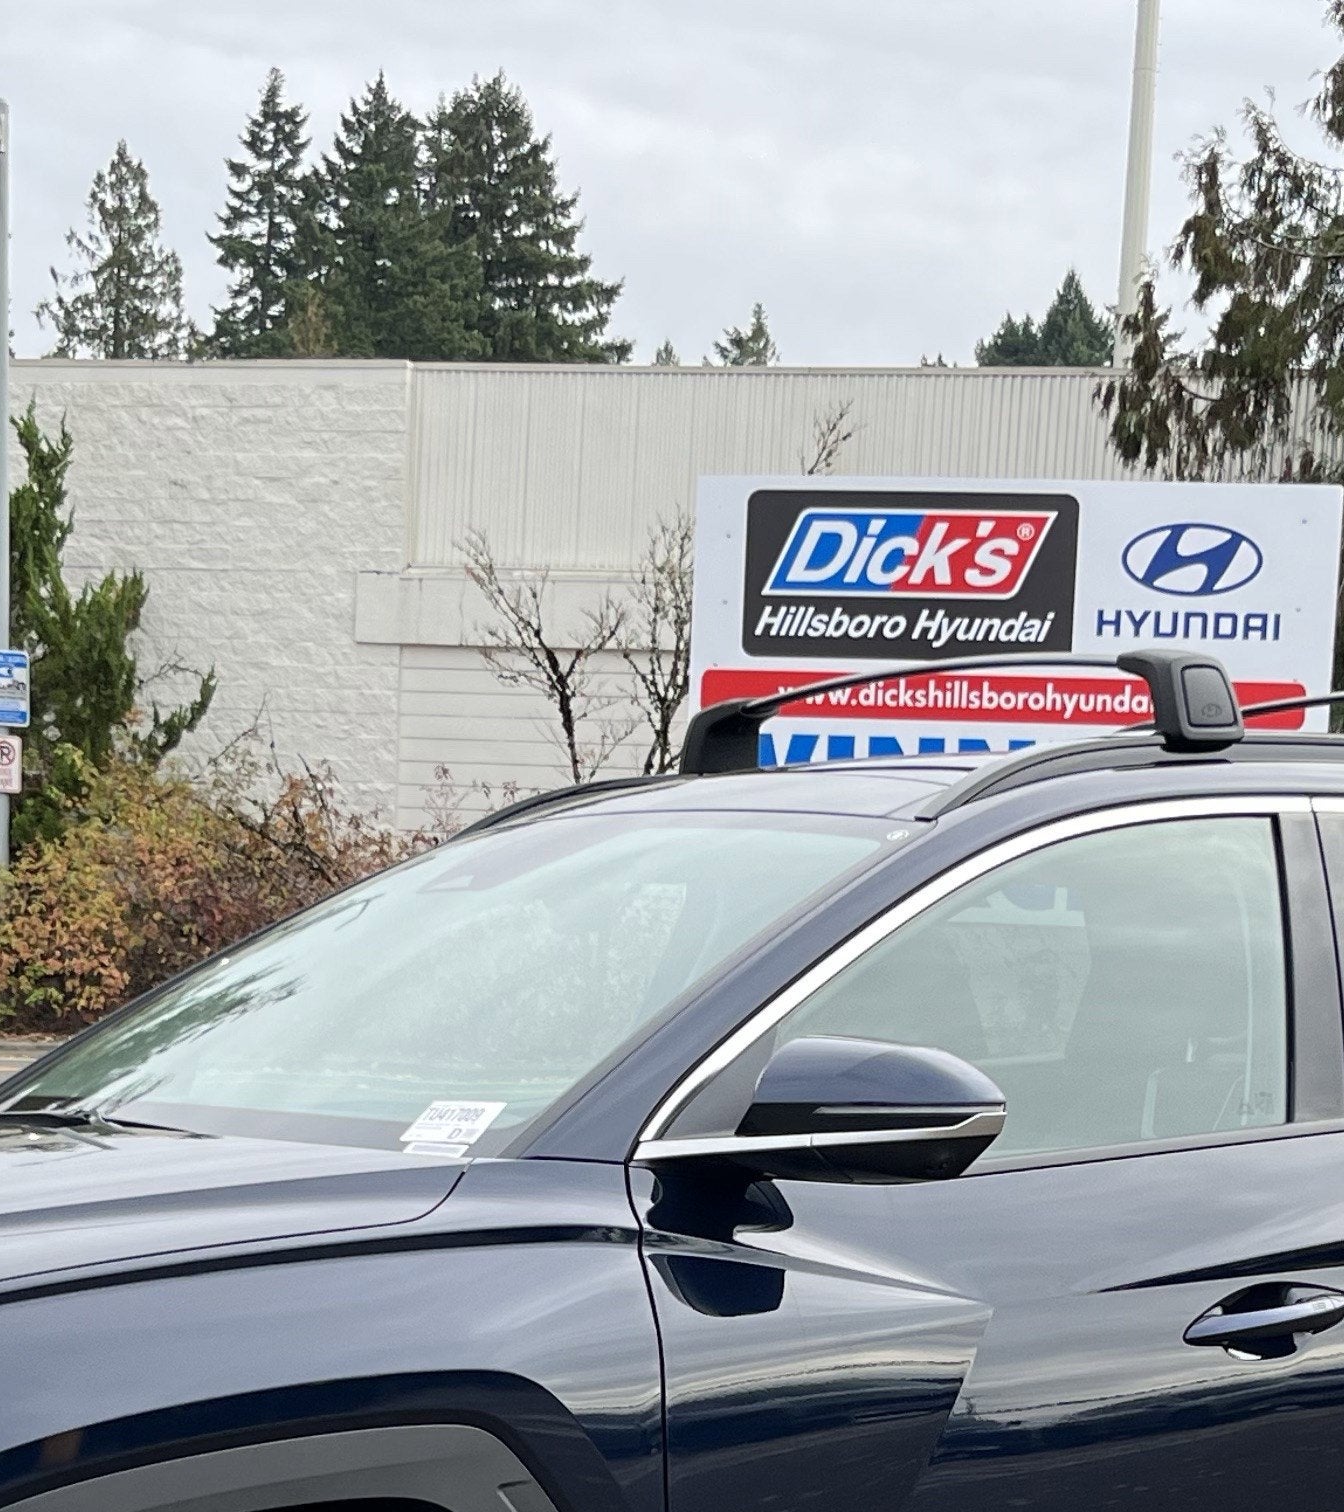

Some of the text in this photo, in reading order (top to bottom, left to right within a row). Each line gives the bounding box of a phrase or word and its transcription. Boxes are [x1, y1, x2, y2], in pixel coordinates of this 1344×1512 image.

[785, 518, 1020, 588] Dick's
[754, 604, 1056, 649] Hillsboro Hyundai
[1095, 608, 1282, 642] HYUNDAI
